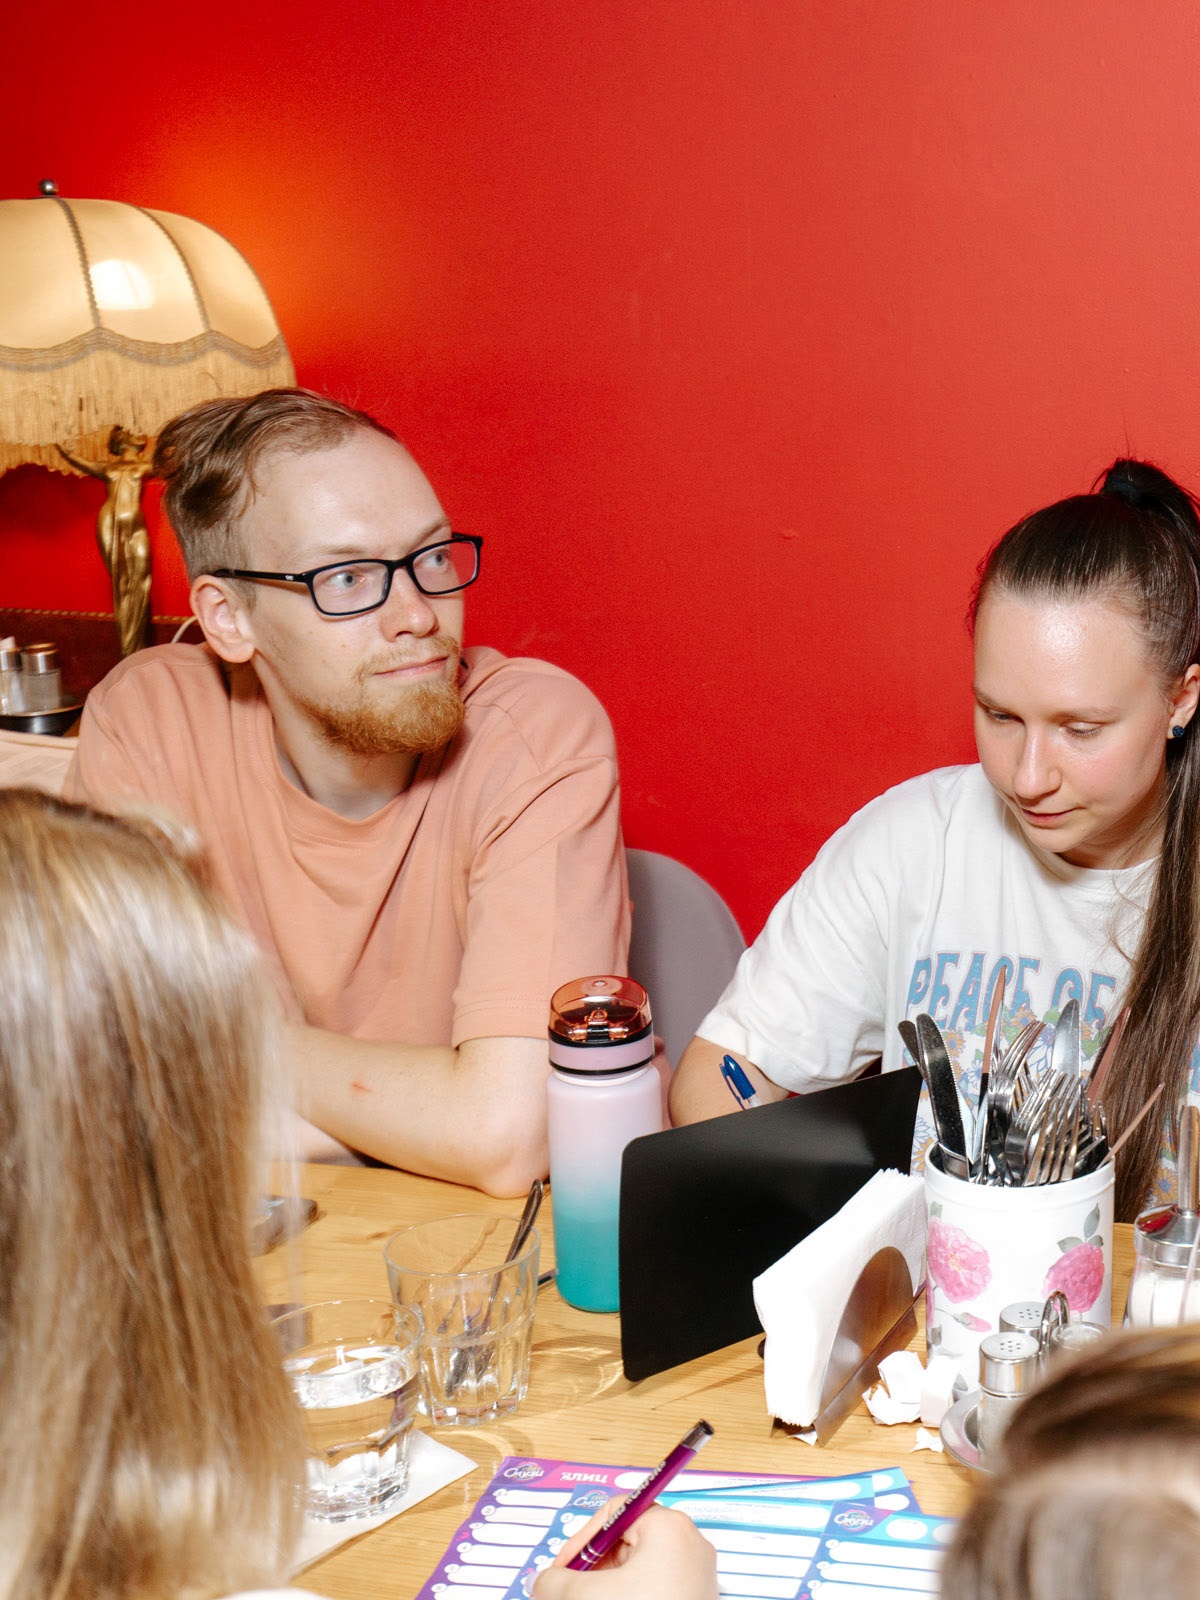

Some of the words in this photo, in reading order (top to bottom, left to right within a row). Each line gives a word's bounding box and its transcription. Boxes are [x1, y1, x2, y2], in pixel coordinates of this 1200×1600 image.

[906, 951, 1042, 1033] PEACE
[1050, 967, 1118, 1030] OF
[503, 1467, 545, 1479] Смузи
